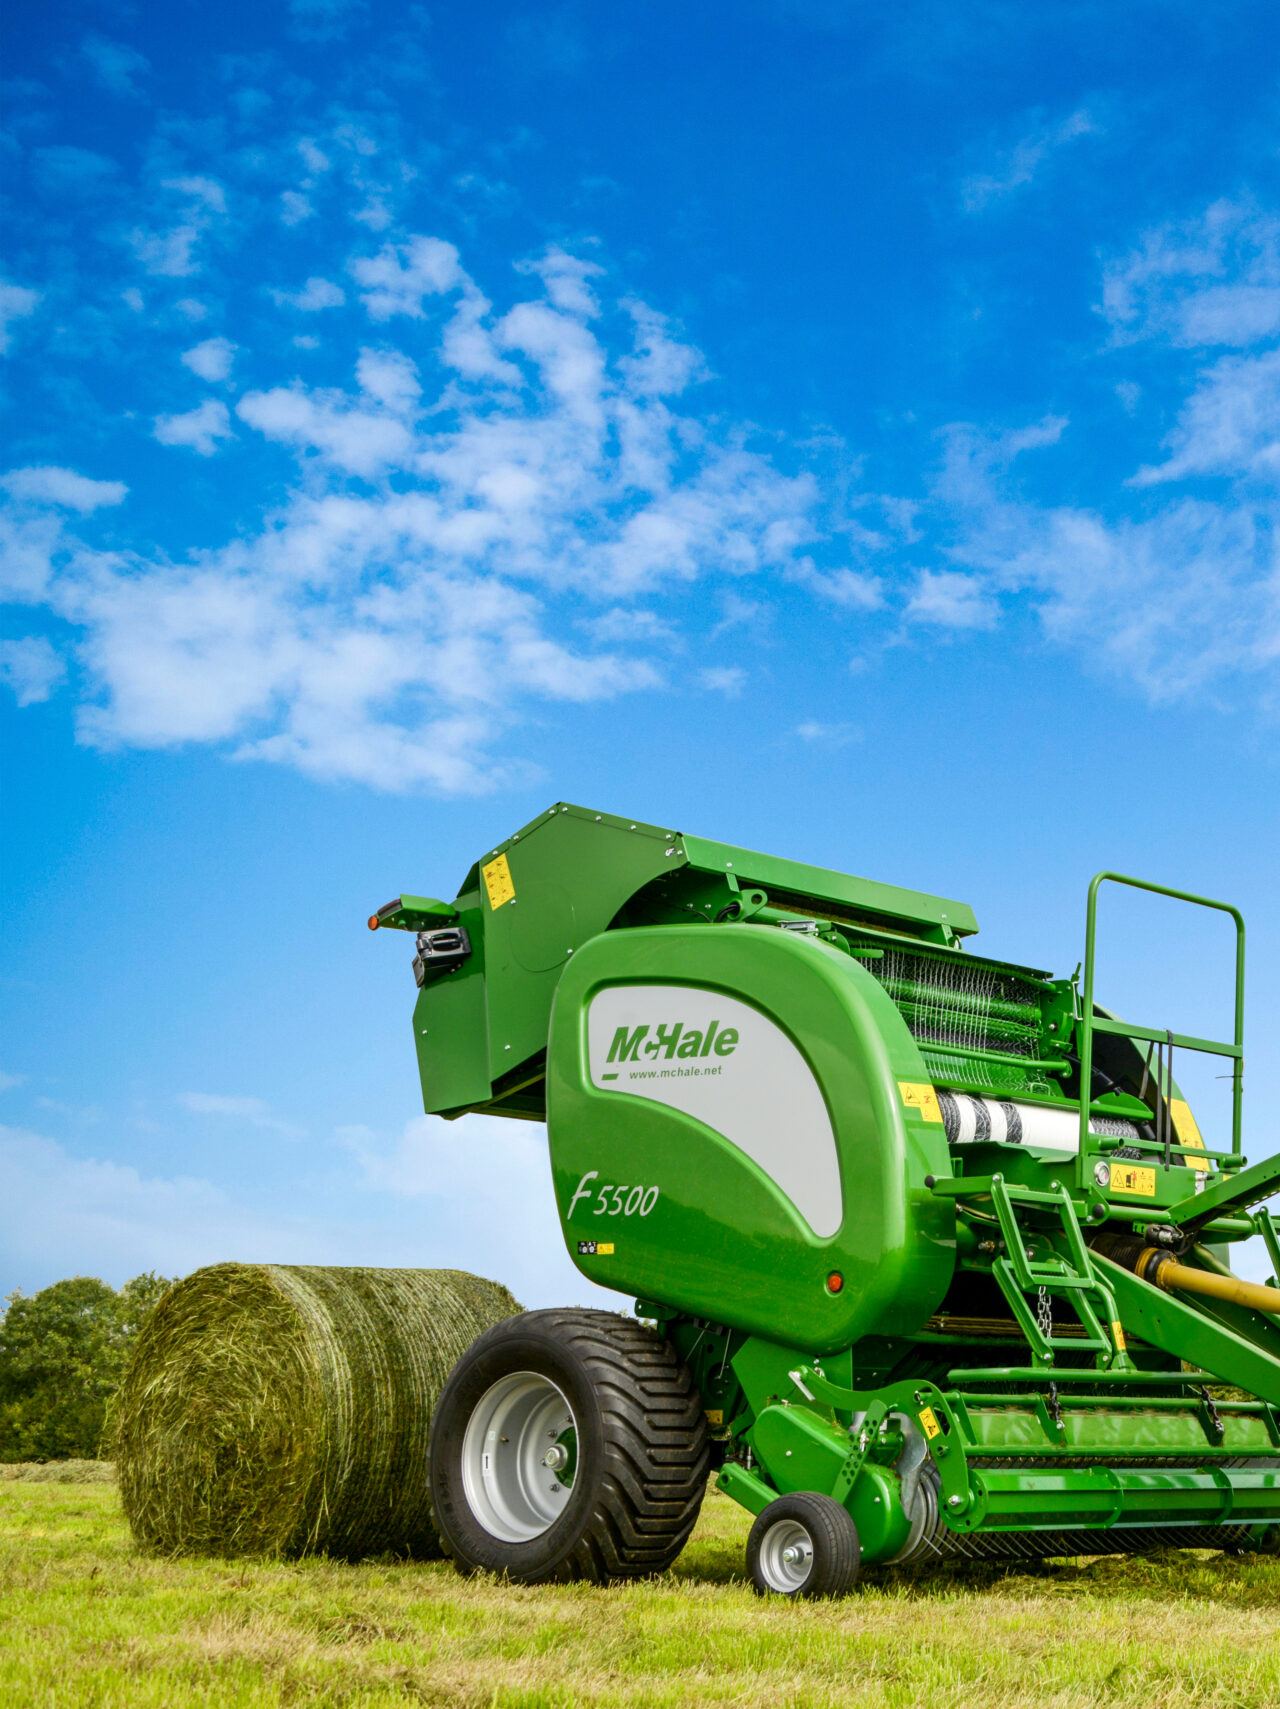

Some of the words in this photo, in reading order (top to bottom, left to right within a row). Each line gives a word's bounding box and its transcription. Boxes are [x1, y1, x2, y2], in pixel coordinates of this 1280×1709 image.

[606, 1020, 739, 1063] McHale
[629, 1065, 722, 1080] www.mchale.net
[592, 1185, 659, 1217] 5500
